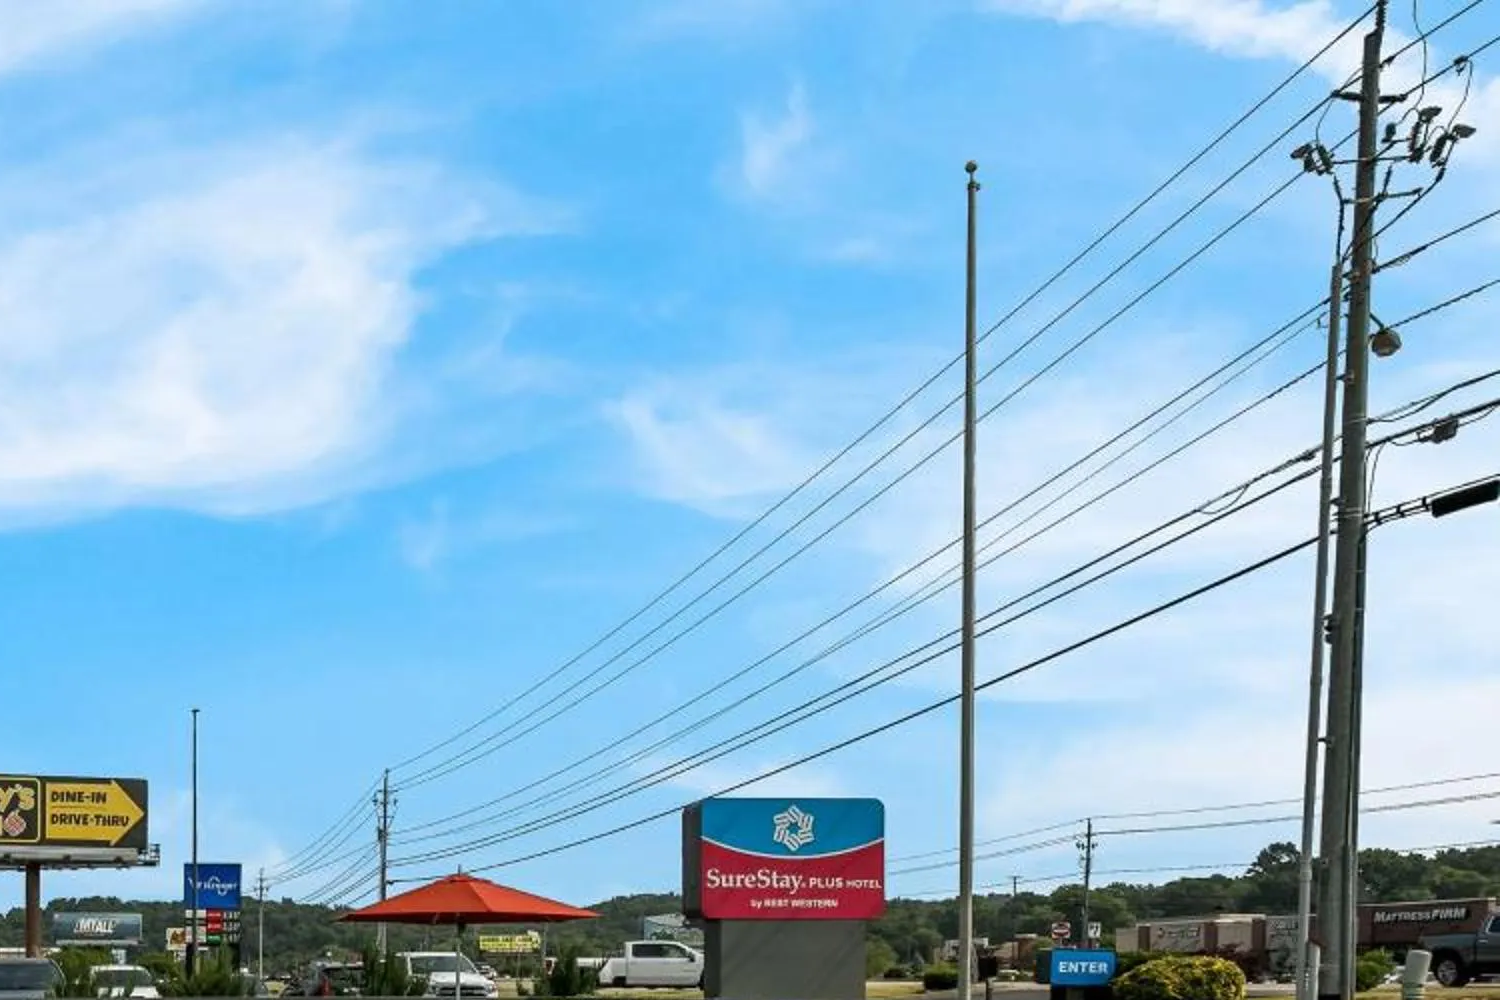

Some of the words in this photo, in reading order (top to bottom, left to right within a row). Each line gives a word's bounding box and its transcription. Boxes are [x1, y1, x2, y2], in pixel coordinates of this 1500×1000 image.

[51, 791, 107, 804] DINE-IN
[51, 814, 129, 827] DRIVE-THRU
[706, 869, 802, 894] SureStay
[809, 877, 843, 889] PLUS
[846, 879, 883, 889] HOTEL
[1059, 961, 1109, 975] ENTER
